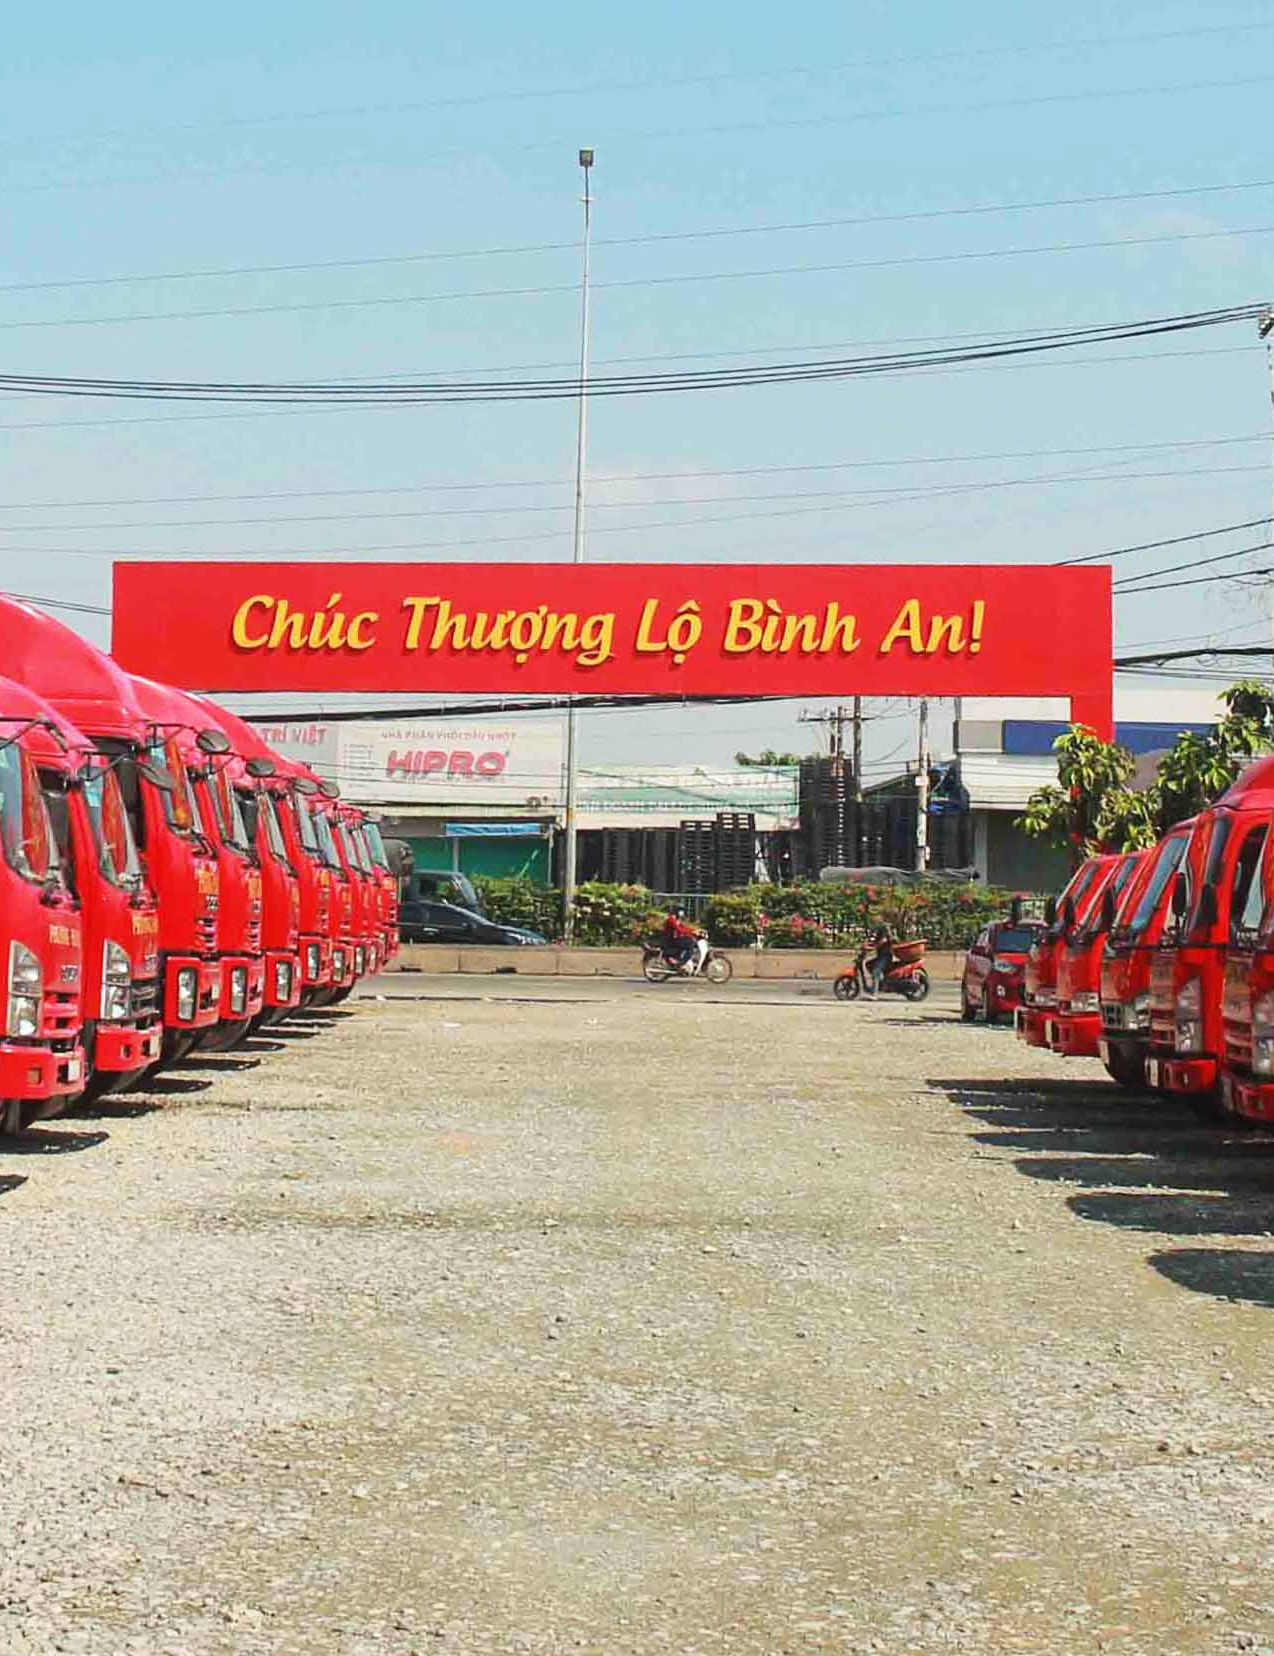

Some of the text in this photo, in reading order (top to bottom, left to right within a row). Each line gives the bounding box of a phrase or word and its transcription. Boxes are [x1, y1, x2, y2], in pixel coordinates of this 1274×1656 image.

[231, 593, 986, 667] Chúc Thượng Lộ Bình An!
[387, 749, 506, 777] HIPRO
